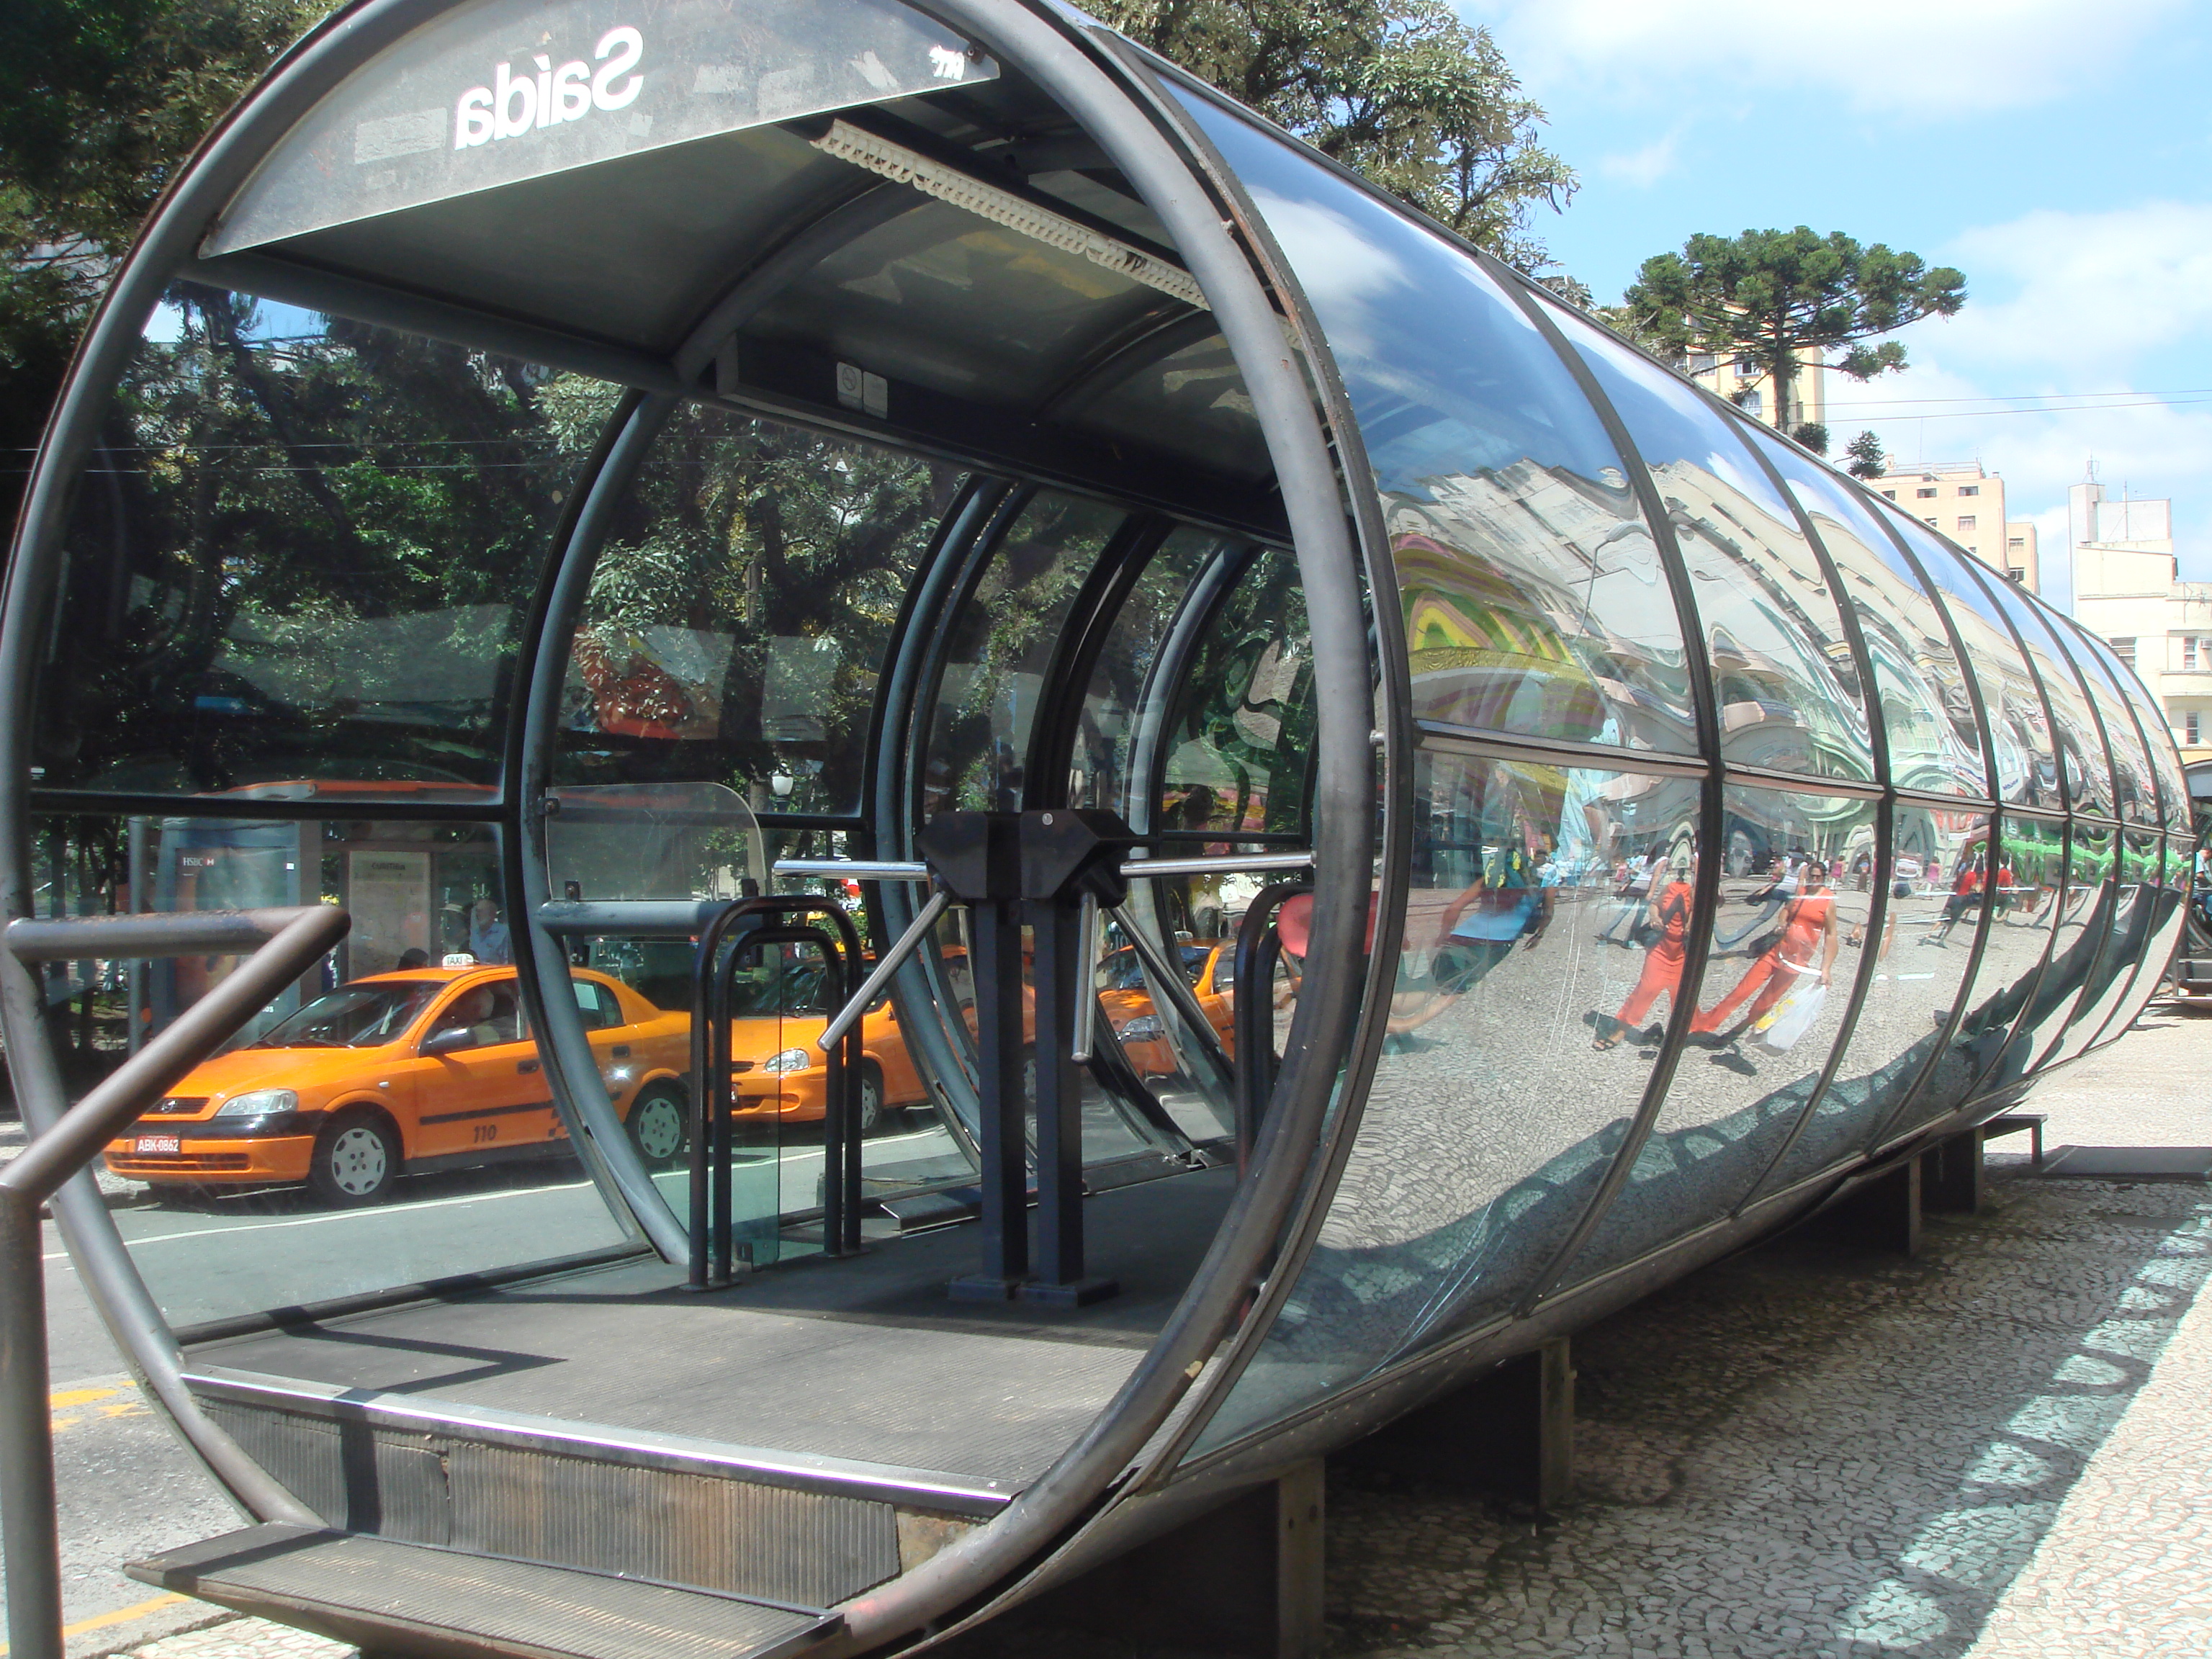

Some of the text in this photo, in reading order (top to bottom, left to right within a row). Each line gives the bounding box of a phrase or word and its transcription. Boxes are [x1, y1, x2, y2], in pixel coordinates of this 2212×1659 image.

[183, 857, 203, 866] HSBC
[446, 956, 462, 965] TAXI
[474, 1124, 497, 1143] 110
[138, 1139, 179, 1151] ABK-0862
